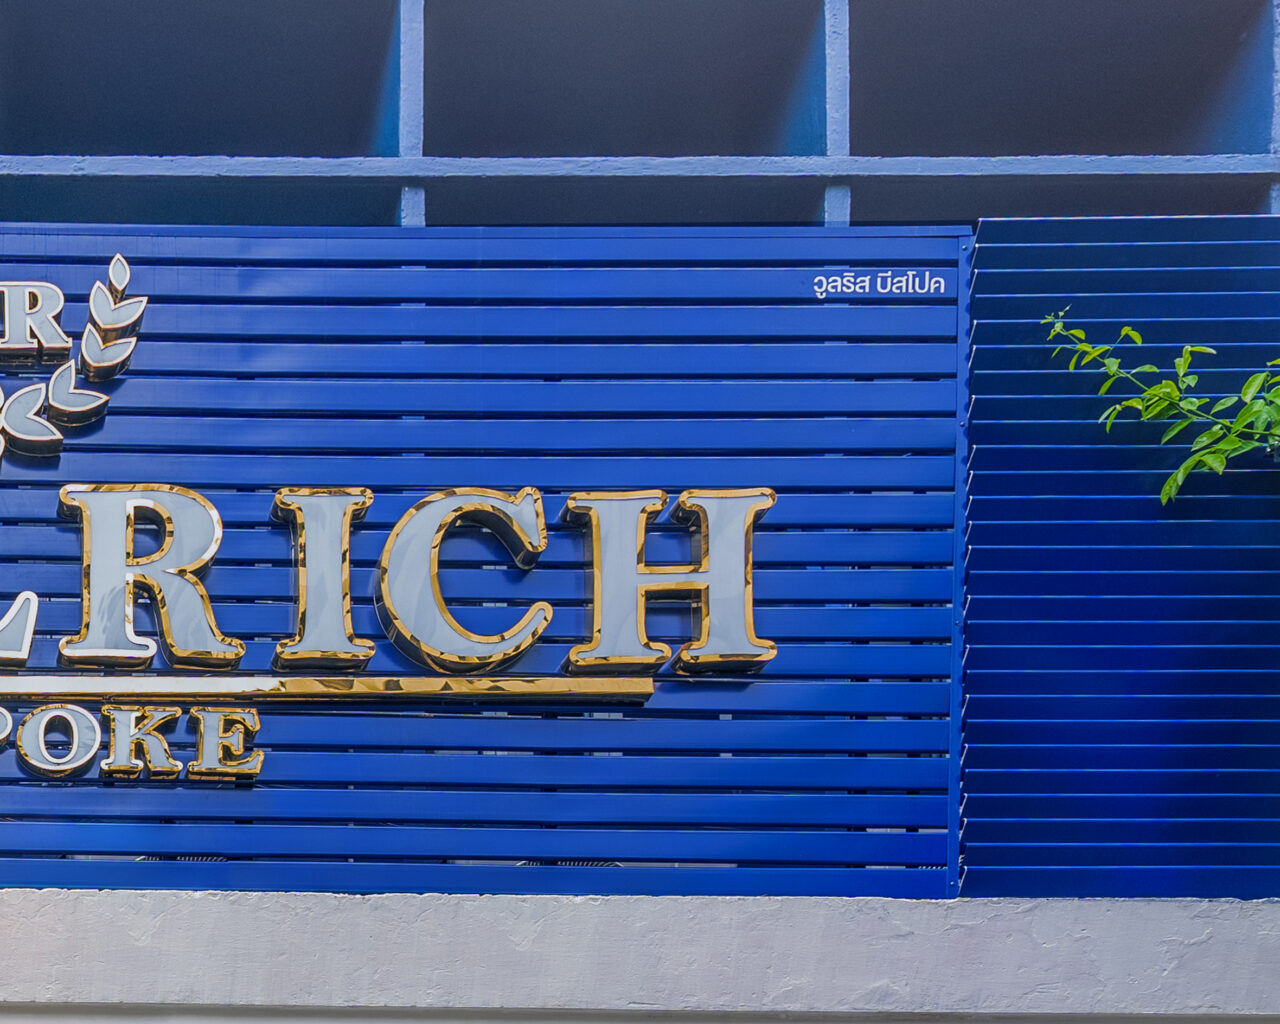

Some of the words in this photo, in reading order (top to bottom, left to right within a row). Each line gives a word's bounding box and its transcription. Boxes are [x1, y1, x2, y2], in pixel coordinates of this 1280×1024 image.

[813, 272, 871, 299] วูลริส
[876, 271, 945, 293] บีสโปค
